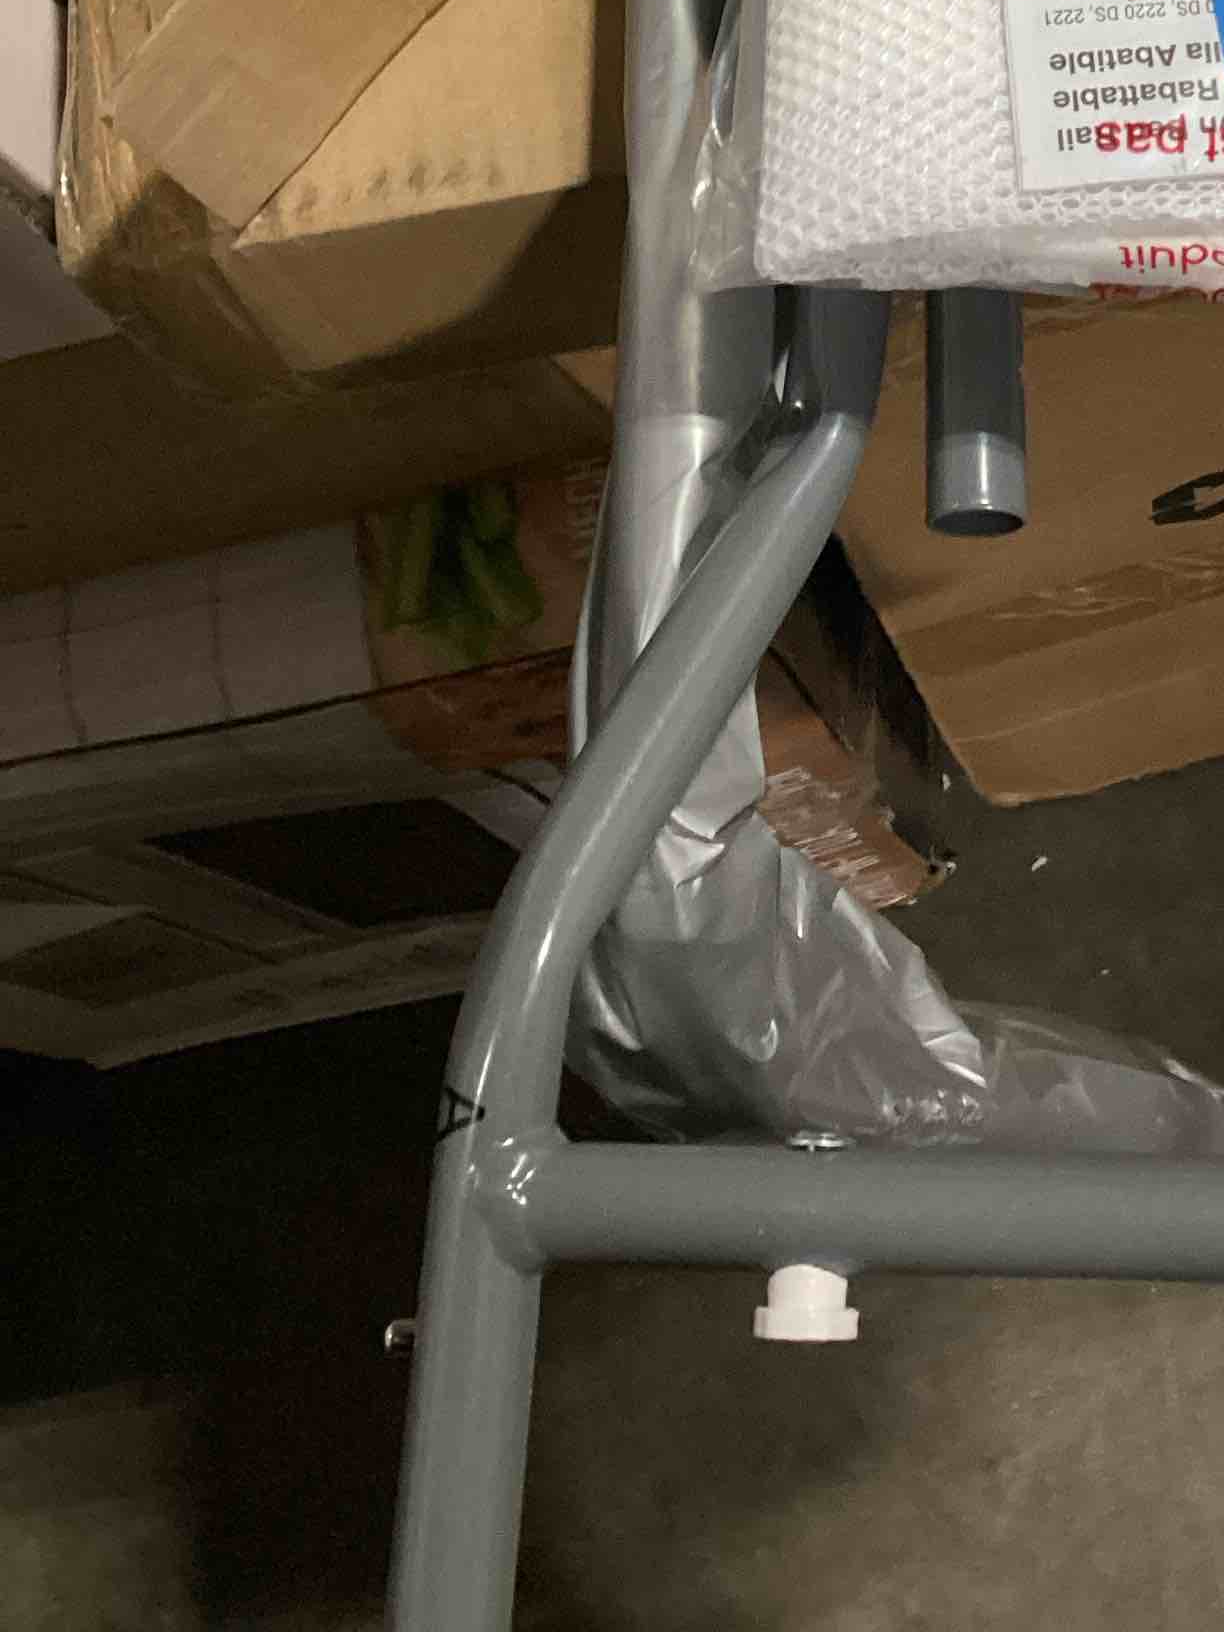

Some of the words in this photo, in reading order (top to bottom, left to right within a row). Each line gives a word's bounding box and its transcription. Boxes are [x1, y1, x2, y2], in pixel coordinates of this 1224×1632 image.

[1044, 8, 1083, 26] 2221
[1124, 1, 1165, 19] 2220
[1049, 44, 1176, 74] Abatible
[1186, 41, 1220, 64] lla
[1053, 78, 1219, 112] Rabattable
[1095, 114, 1186, 155] pas
